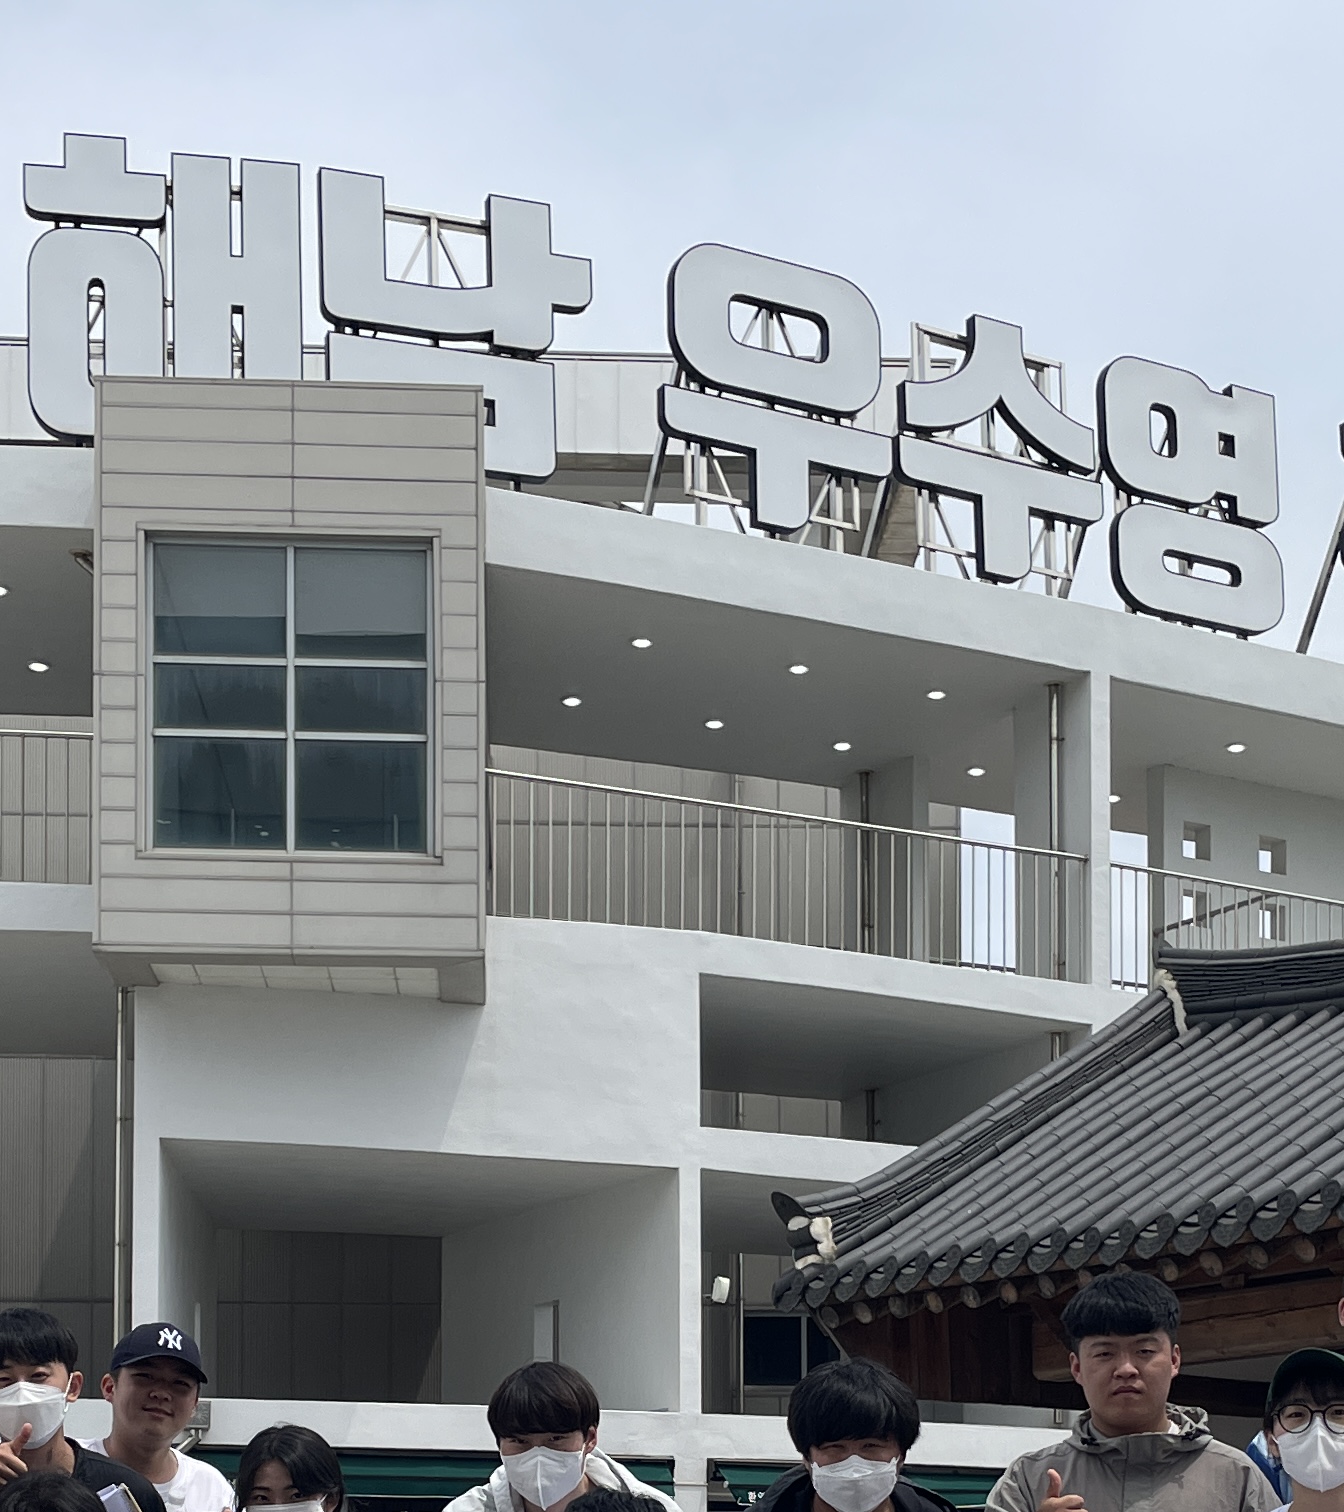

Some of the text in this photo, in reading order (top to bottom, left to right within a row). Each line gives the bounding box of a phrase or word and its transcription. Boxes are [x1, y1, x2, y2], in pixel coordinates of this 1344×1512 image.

[23, 132, 592, 485] 해남
[658, 242, 1284, 637] 우수영
[157, 1327, 183, 1350] NY
